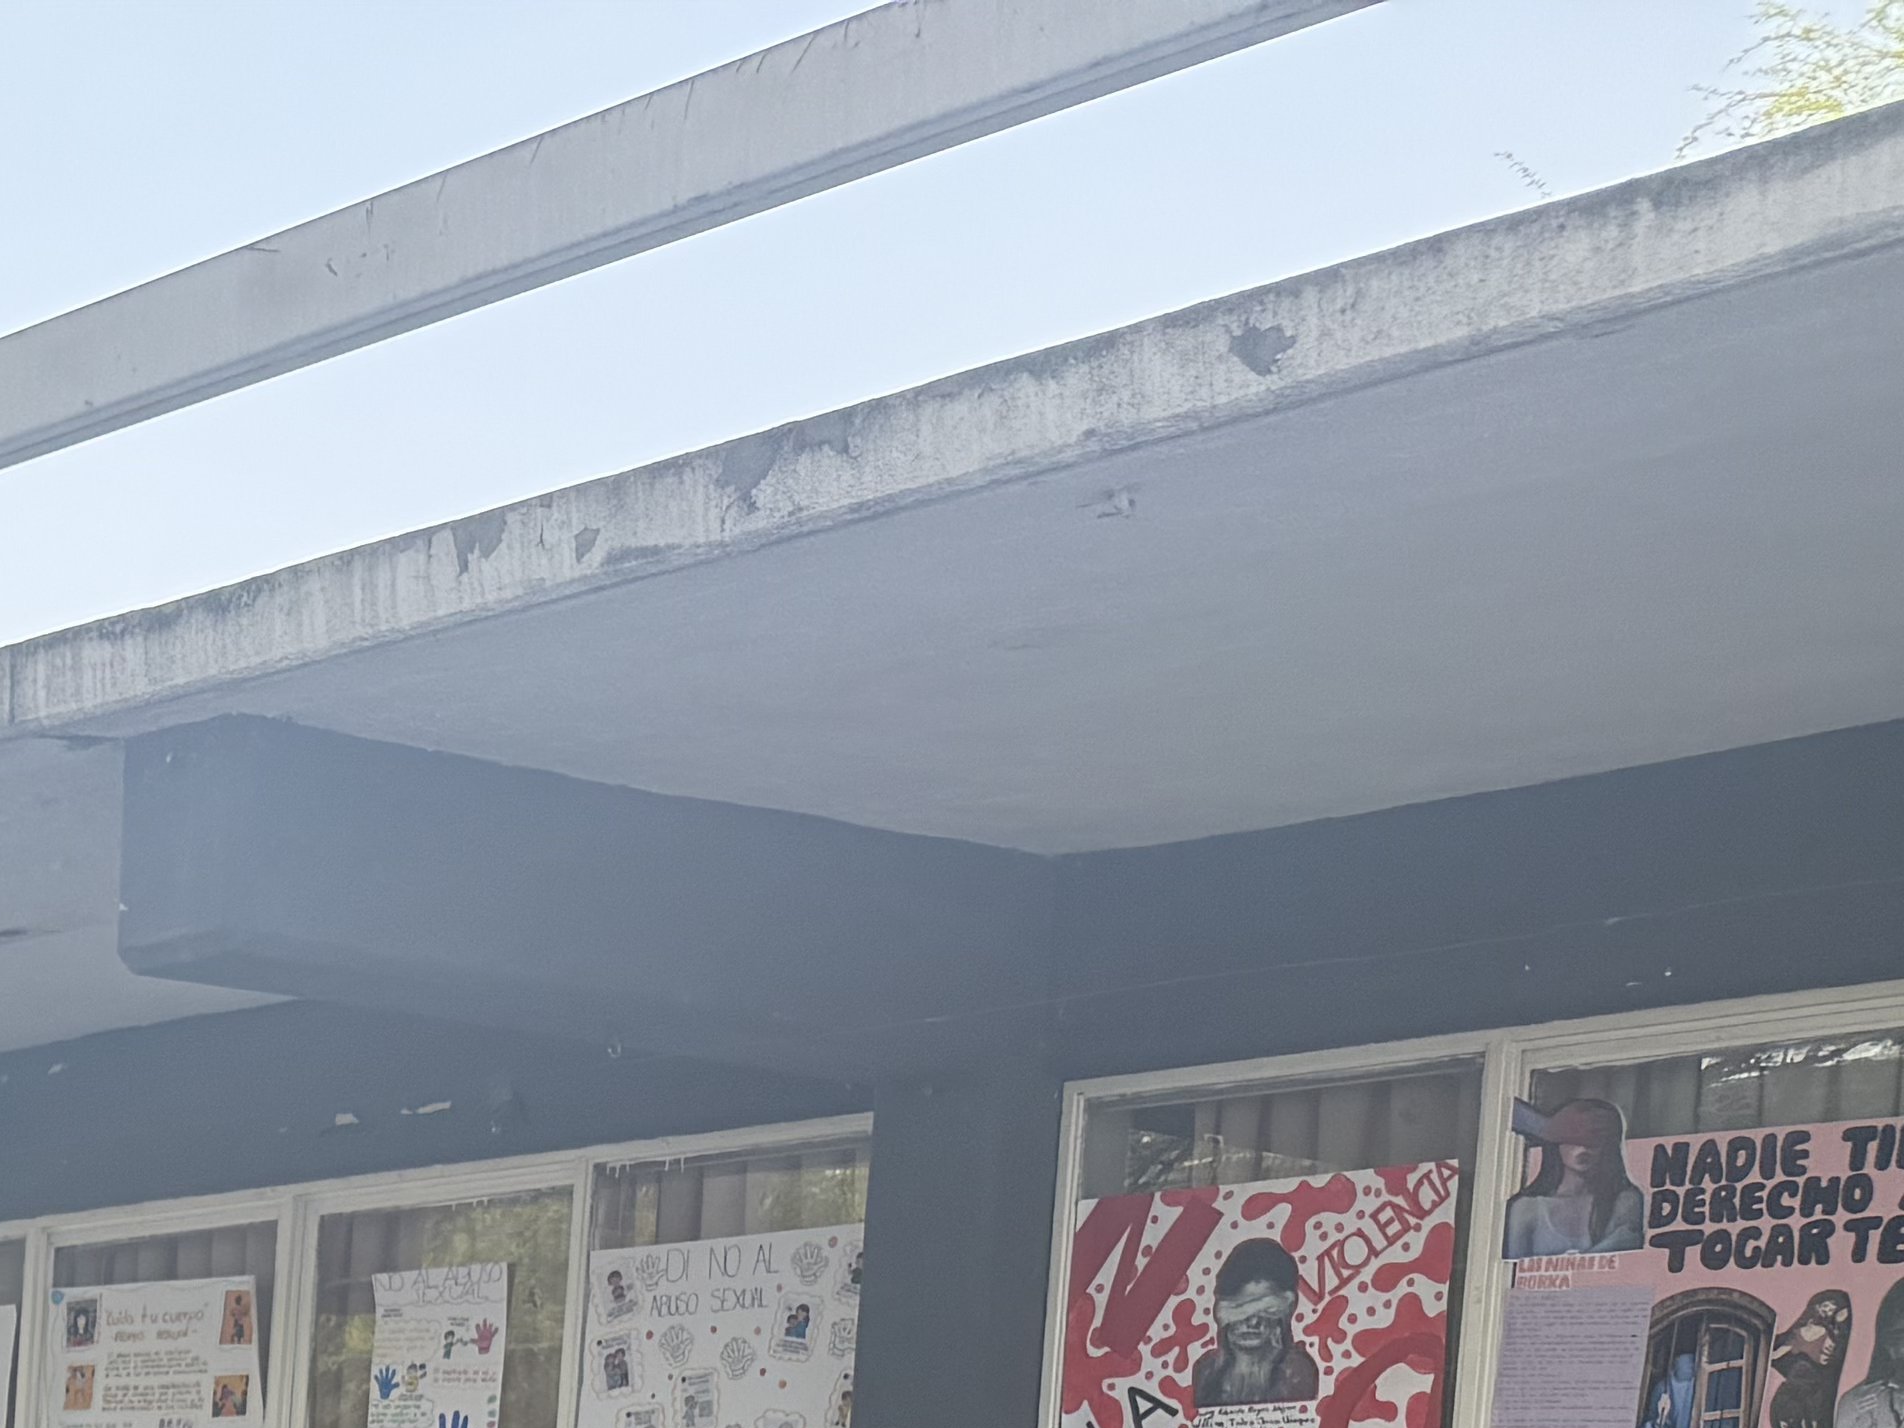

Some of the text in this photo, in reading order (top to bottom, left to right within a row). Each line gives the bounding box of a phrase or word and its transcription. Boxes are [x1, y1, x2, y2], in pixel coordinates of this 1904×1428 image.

[1650, 1123, 1904, 1189] NADIE TI
[1648, 1172, 1874, 1229] DERECHO
[1297, 1158, 1459, 1306] VIOLENCIA
[666, 1242, 780, 1283] DI NO AL
[650, 1286, 769, 1318] ABUSO SEXUAL
